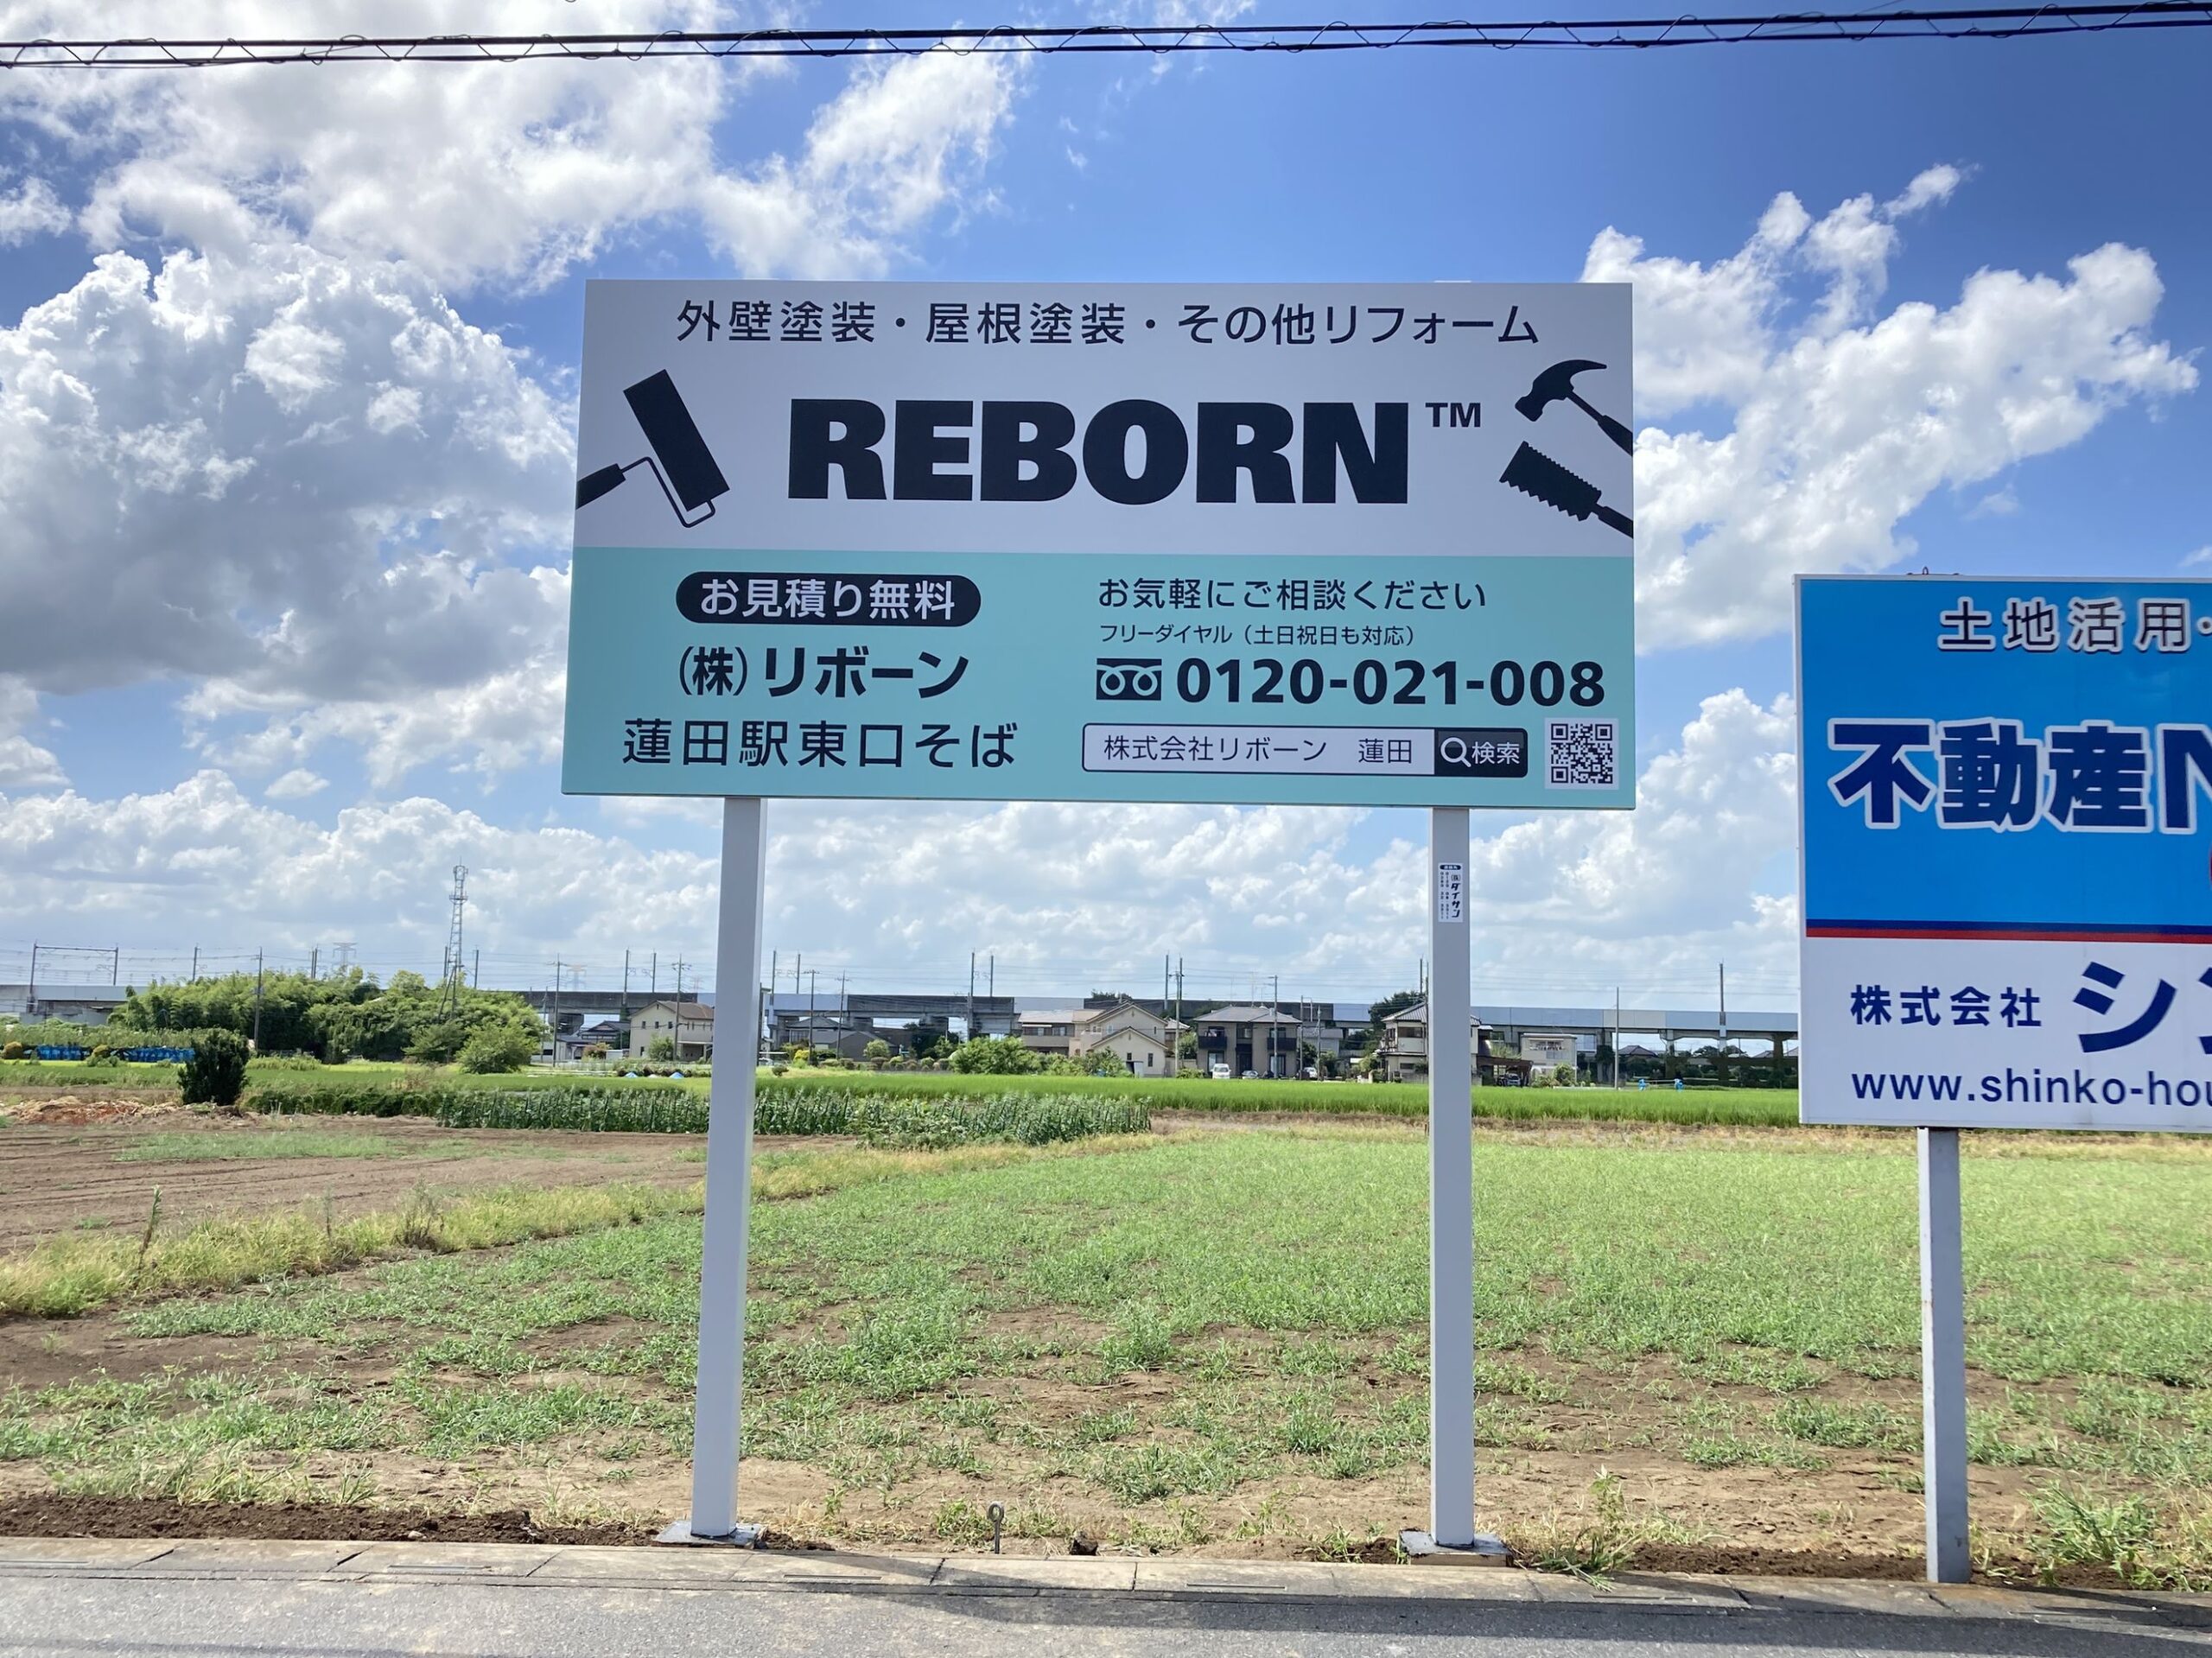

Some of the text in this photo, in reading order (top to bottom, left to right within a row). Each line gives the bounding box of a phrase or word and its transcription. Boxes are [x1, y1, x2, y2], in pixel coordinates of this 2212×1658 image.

[677, 299, 1540, 345] 外壁塗装・屋根塗装・その他リフォーム
[788, 398, 1409, 505] REBORN
[701, 579, 956, 620] お見積り無料
[1098, 578, 1486, 611] お気軽にご相談ください
[1176, 657, 1605, 708] 0120-021-008
[622, 718, 1018, 768] 蓮田駅東口そば
[1103, 734, 1414, 765] 株式会社リボーン 蓮田
[1471, 741, 1521, 765] 検索
[1850, 984, 2042, 1028] 株式会社
